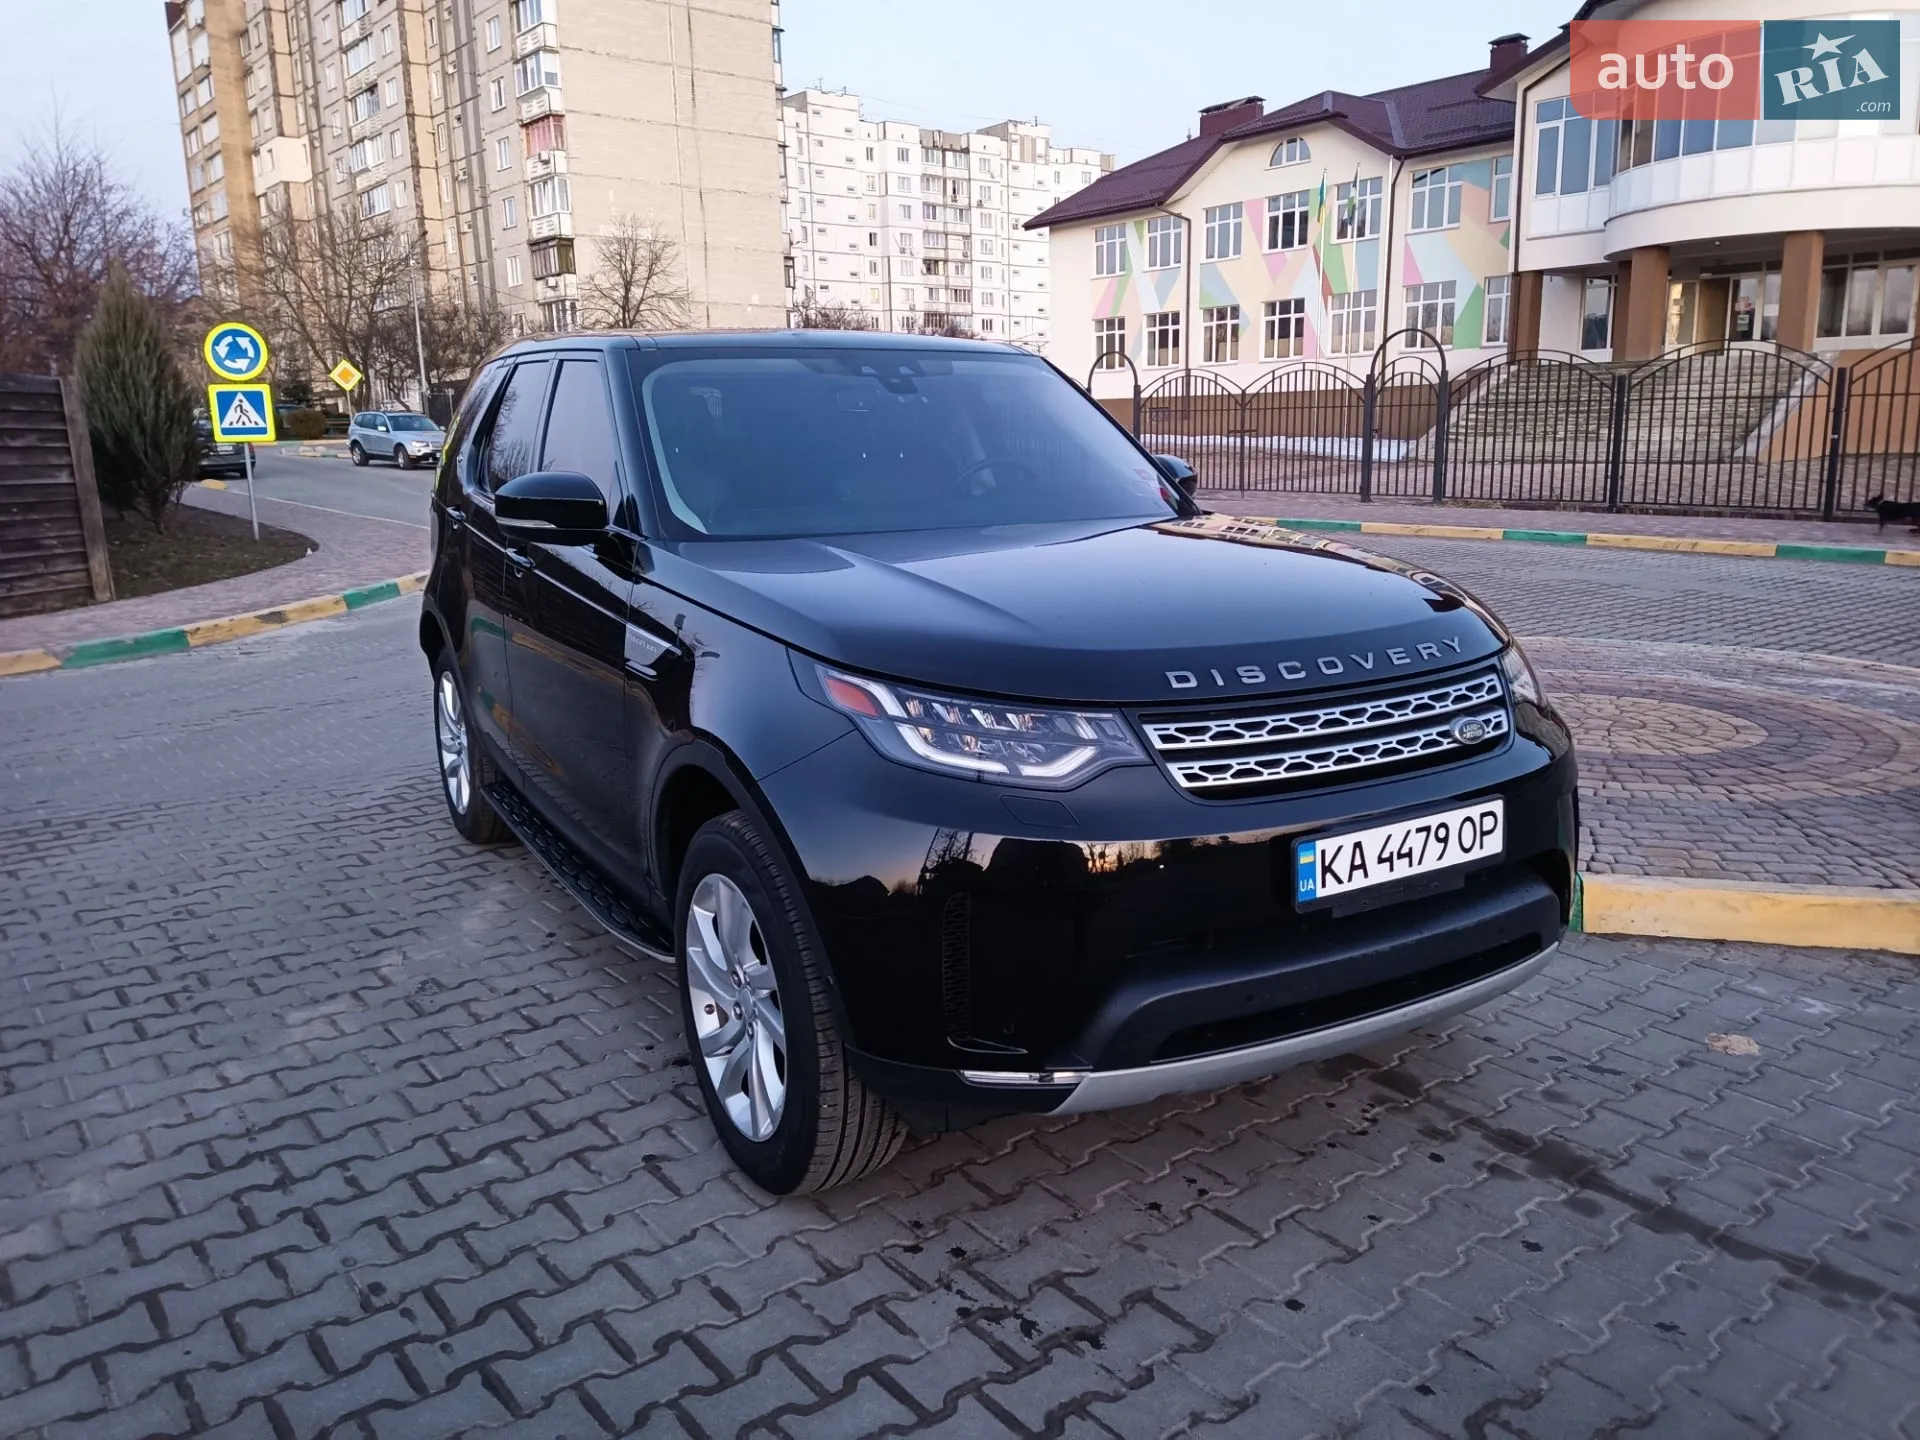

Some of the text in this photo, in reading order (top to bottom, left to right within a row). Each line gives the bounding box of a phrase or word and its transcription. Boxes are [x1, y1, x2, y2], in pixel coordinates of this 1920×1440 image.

[1165, 636, 1464, 689] DISCOVERY
[1320, 810, 1498, 888] KA 4479 OP
[1300, 879, 1315, 892] UA
